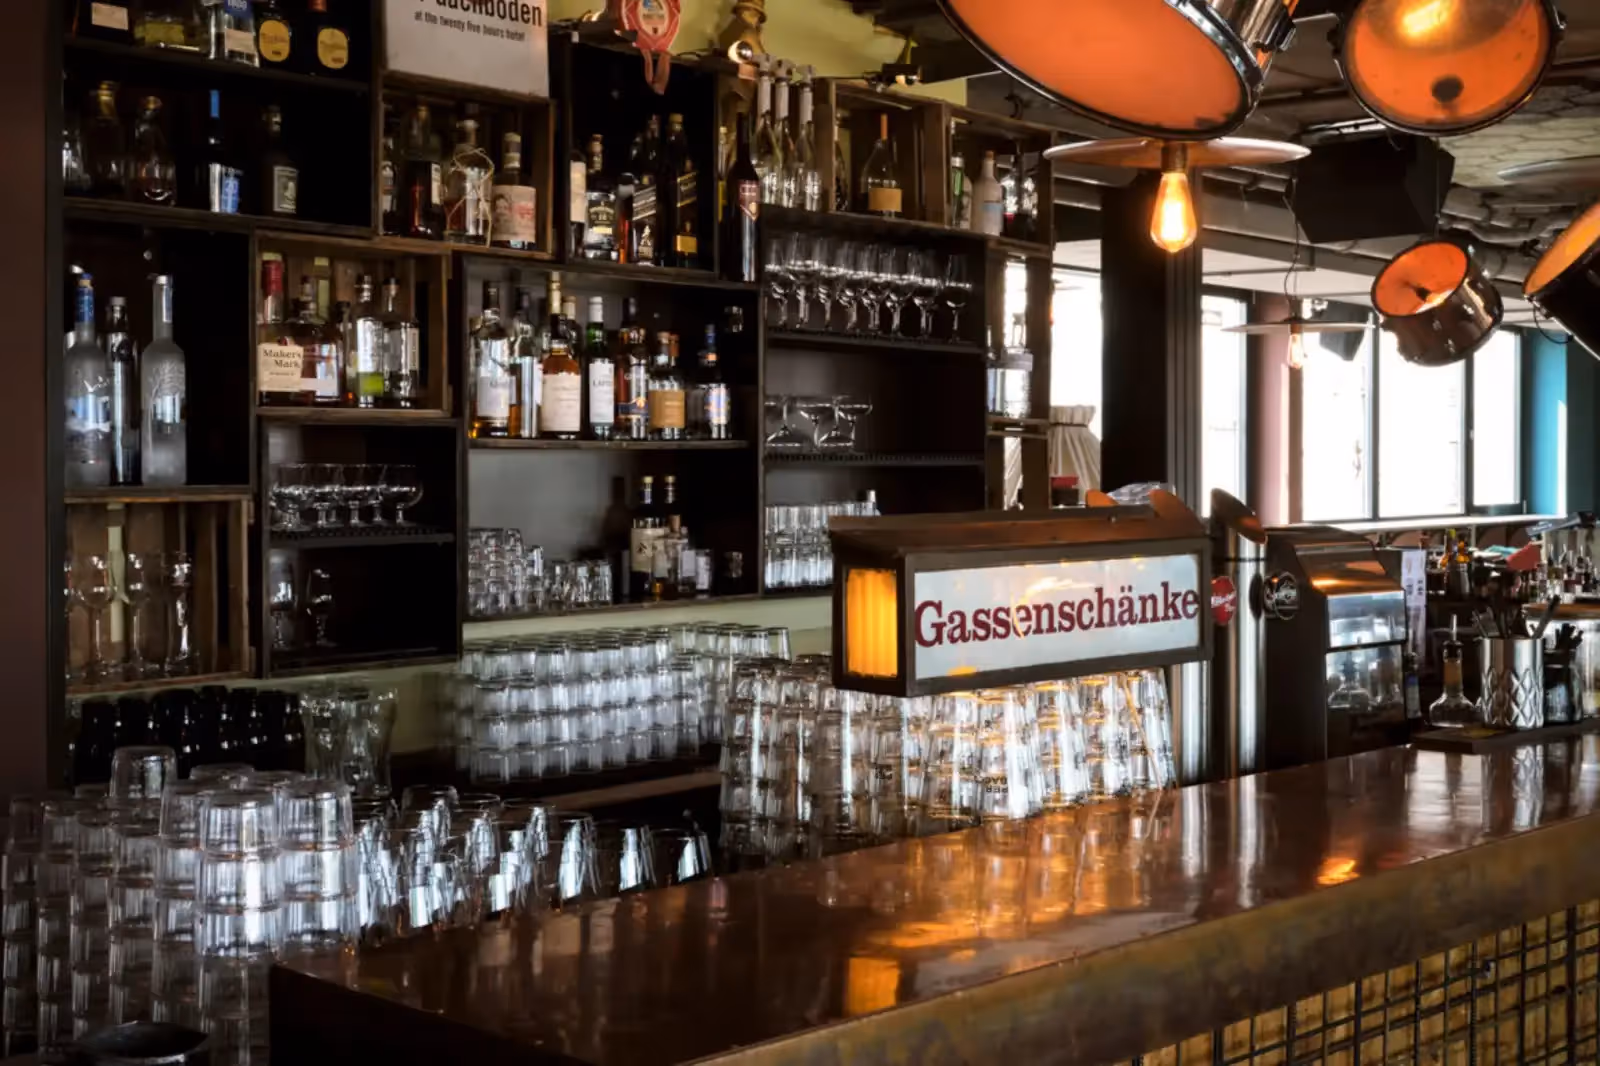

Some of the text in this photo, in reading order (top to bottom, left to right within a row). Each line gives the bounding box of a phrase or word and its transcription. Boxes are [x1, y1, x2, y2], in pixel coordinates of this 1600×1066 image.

[415, 10, 525, 42] at the twenty five hours hotel
[436, 0, 542, 27] chboden
[914, 581, 1200, 648] Gassenschänke
